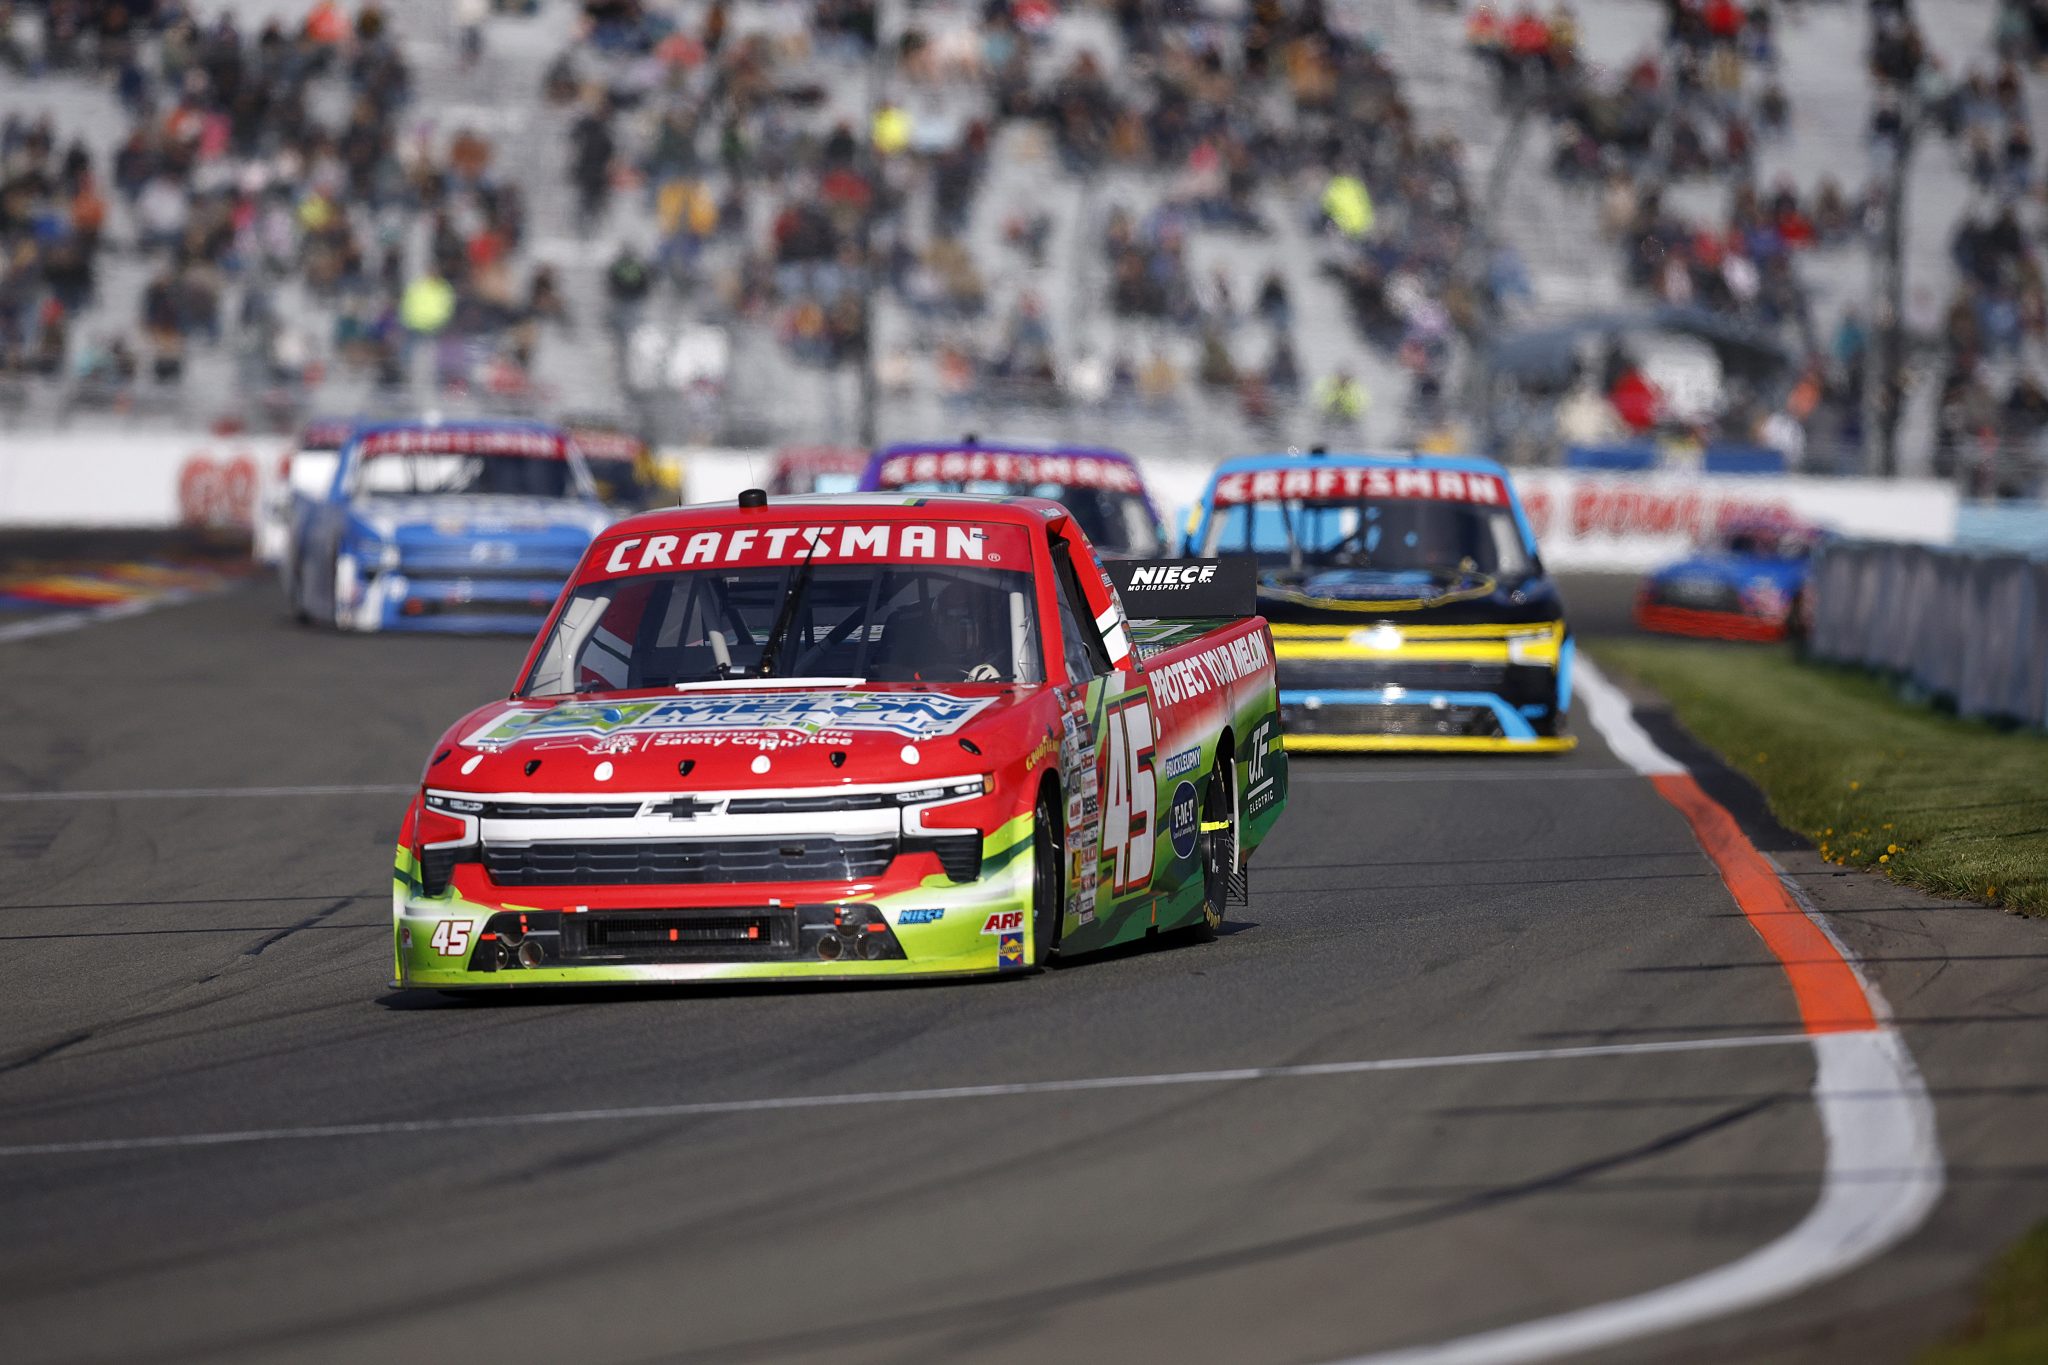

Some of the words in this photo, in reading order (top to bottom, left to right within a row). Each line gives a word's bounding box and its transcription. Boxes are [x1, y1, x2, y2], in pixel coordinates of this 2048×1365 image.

[1217, 468, 1498, 504] CRAFTSMAN
[605, 525, 983, 573] CRAFTSMAN
[1130, 565, 1218, 585] NIECE
[1149, 656, 1211, 709] PROTECT
[1199, 645, 1237, 687] YOUR
[1228, 629, 1269, 678] MELON
[652, 702, 969, 721] MELON
[654, 736, 727, 747] Safety
[1101, 696, 1157, 895] 45
[1250, 790, 1274, 813] ELECTRIC
[984, 911, 1024, 930] ARP
[430, 920, 473, 956] 45
